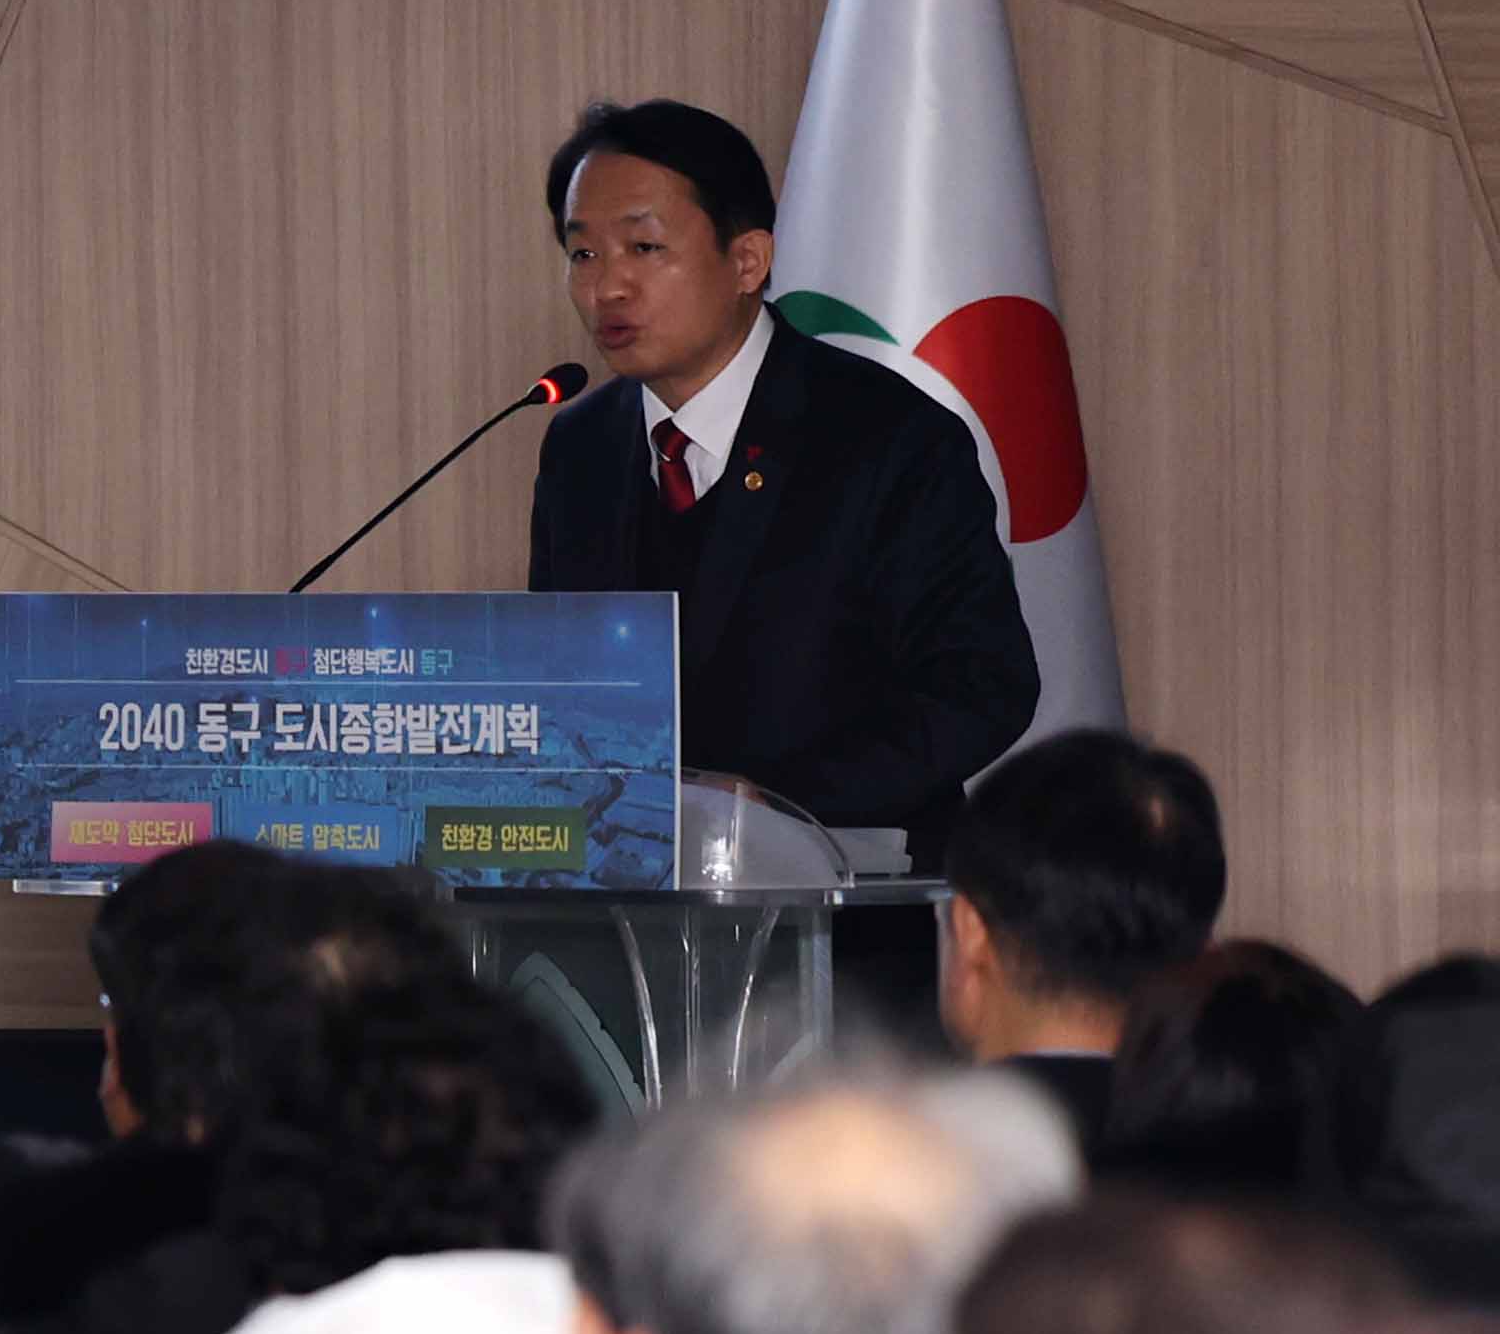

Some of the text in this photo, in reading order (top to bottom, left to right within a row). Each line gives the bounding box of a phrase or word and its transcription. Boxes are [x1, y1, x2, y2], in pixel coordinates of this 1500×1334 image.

[185, 648, 269, 676] 친환경도시
[313, 648, 414, 676] 첨단행복도시
[420, 649, 453, 676] 동구
[99, 702, 539, 755] 2040 동구 도시종합발전계획
